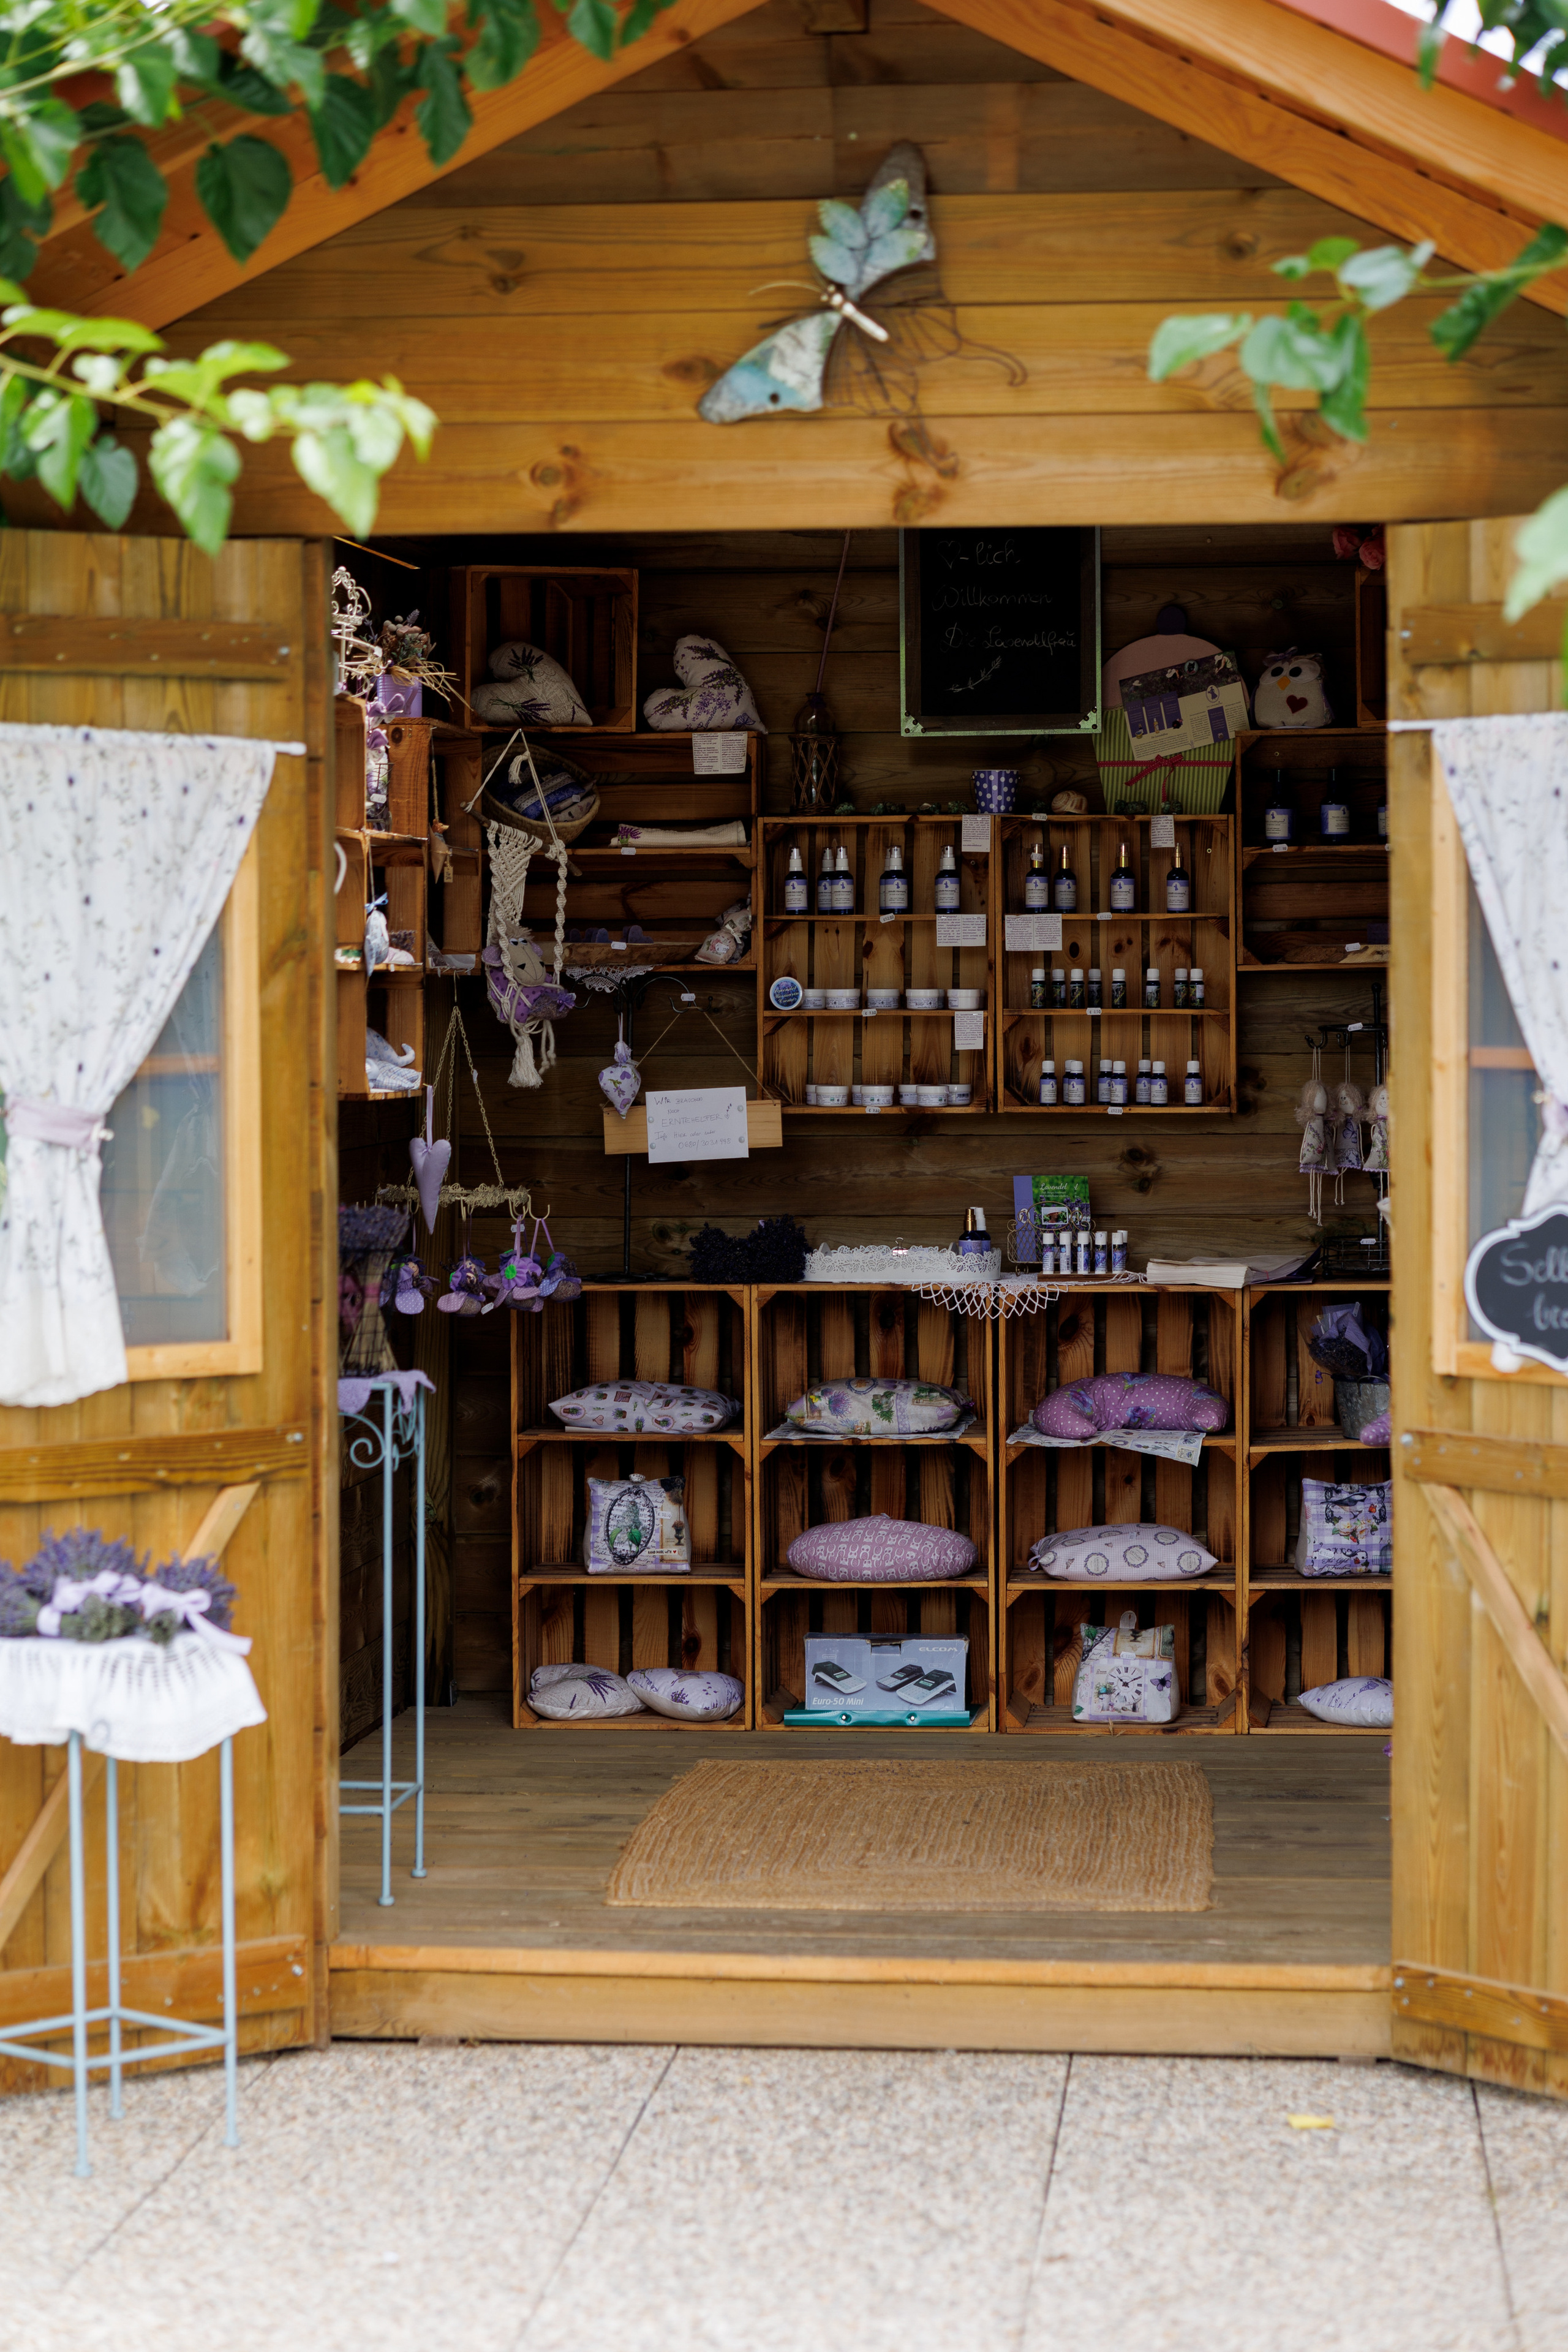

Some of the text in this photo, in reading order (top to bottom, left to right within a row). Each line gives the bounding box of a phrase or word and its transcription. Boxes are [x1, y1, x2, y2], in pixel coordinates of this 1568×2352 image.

[932, 584, 1053, 611] Willkommen
[662, 1114, 723, 1128] ERNTEHELFER
[1039, 1182, 1068, 1191] Lavendel
[812, 1697, 864, 1705] Euro-50 Mini
